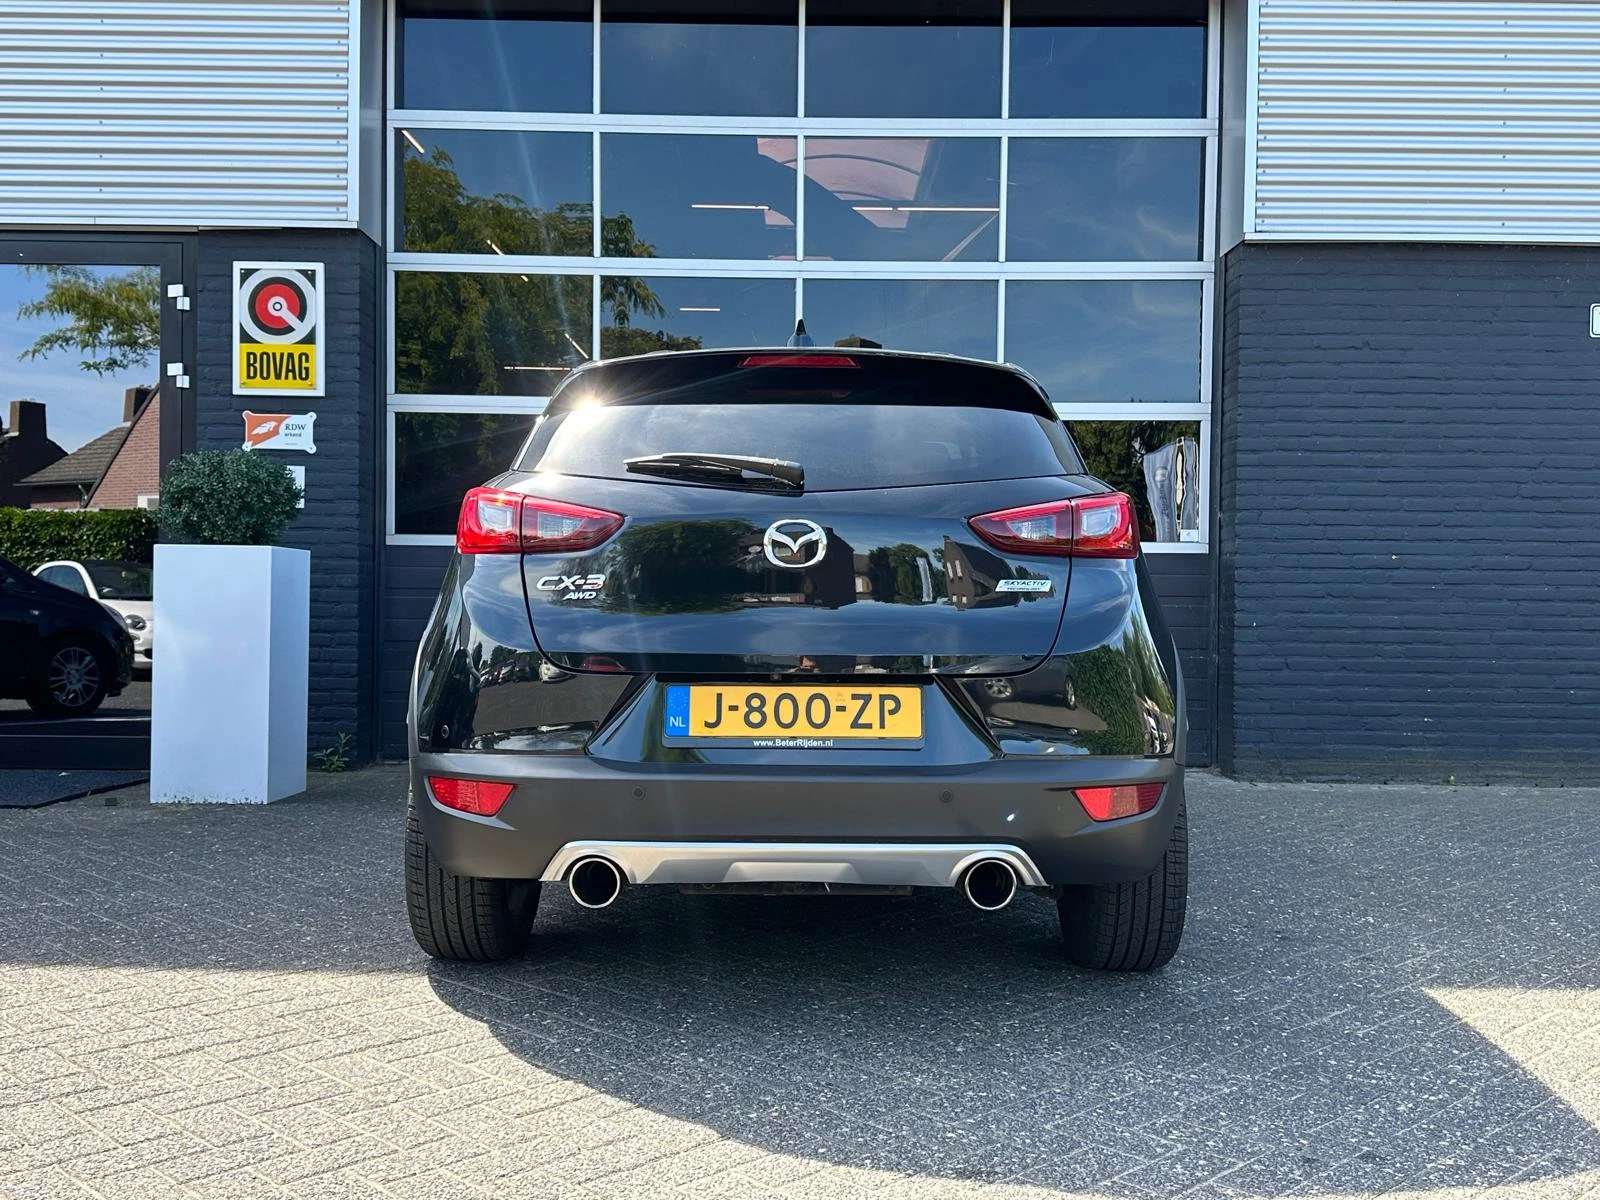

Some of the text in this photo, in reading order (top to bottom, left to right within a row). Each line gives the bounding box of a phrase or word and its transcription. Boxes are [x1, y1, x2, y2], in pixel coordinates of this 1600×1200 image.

[246, 351, 310, 380] BOVAG
[536, 574, 606, 591] CX-3
[562, 591, 597, 600] AWD
[704, 692, 902, 729] J-800-ZP
[669, 716, 686, 727] NL
[753, 738, 833, 748] www.BeterRijden.nl
